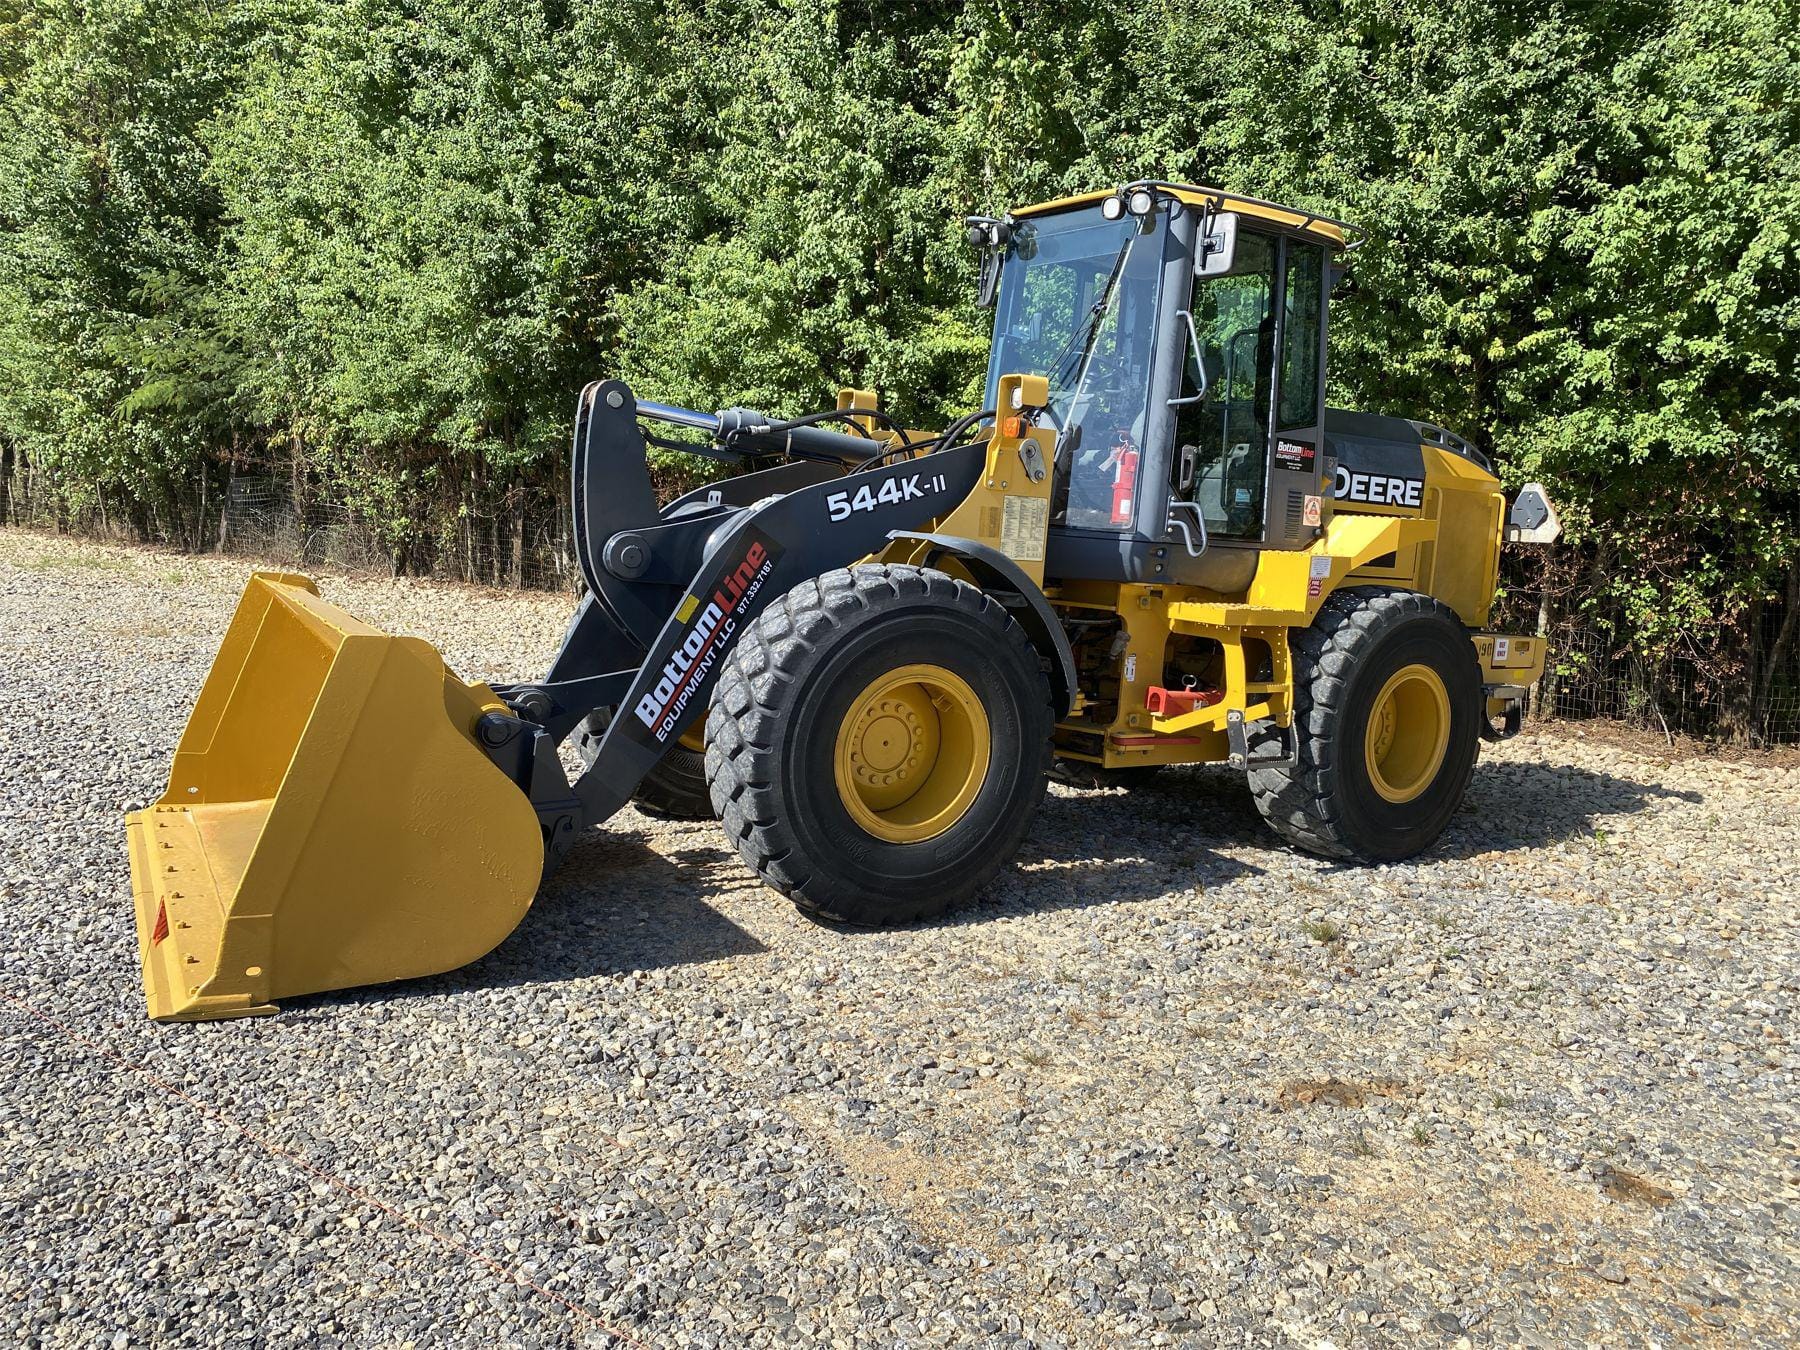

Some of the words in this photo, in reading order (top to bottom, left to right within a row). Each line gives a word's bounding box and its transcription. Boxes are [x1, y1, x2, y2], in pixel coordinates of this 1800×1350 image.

[826, 474, 946, 521] 544K-II
[1335, 466, 1422, 506] DEERE
[737, 560, 773, 614] 877.332.7187
[655, 646, 717, 742] EQUIPMENT
[714, 617, 737, 649] LLC
